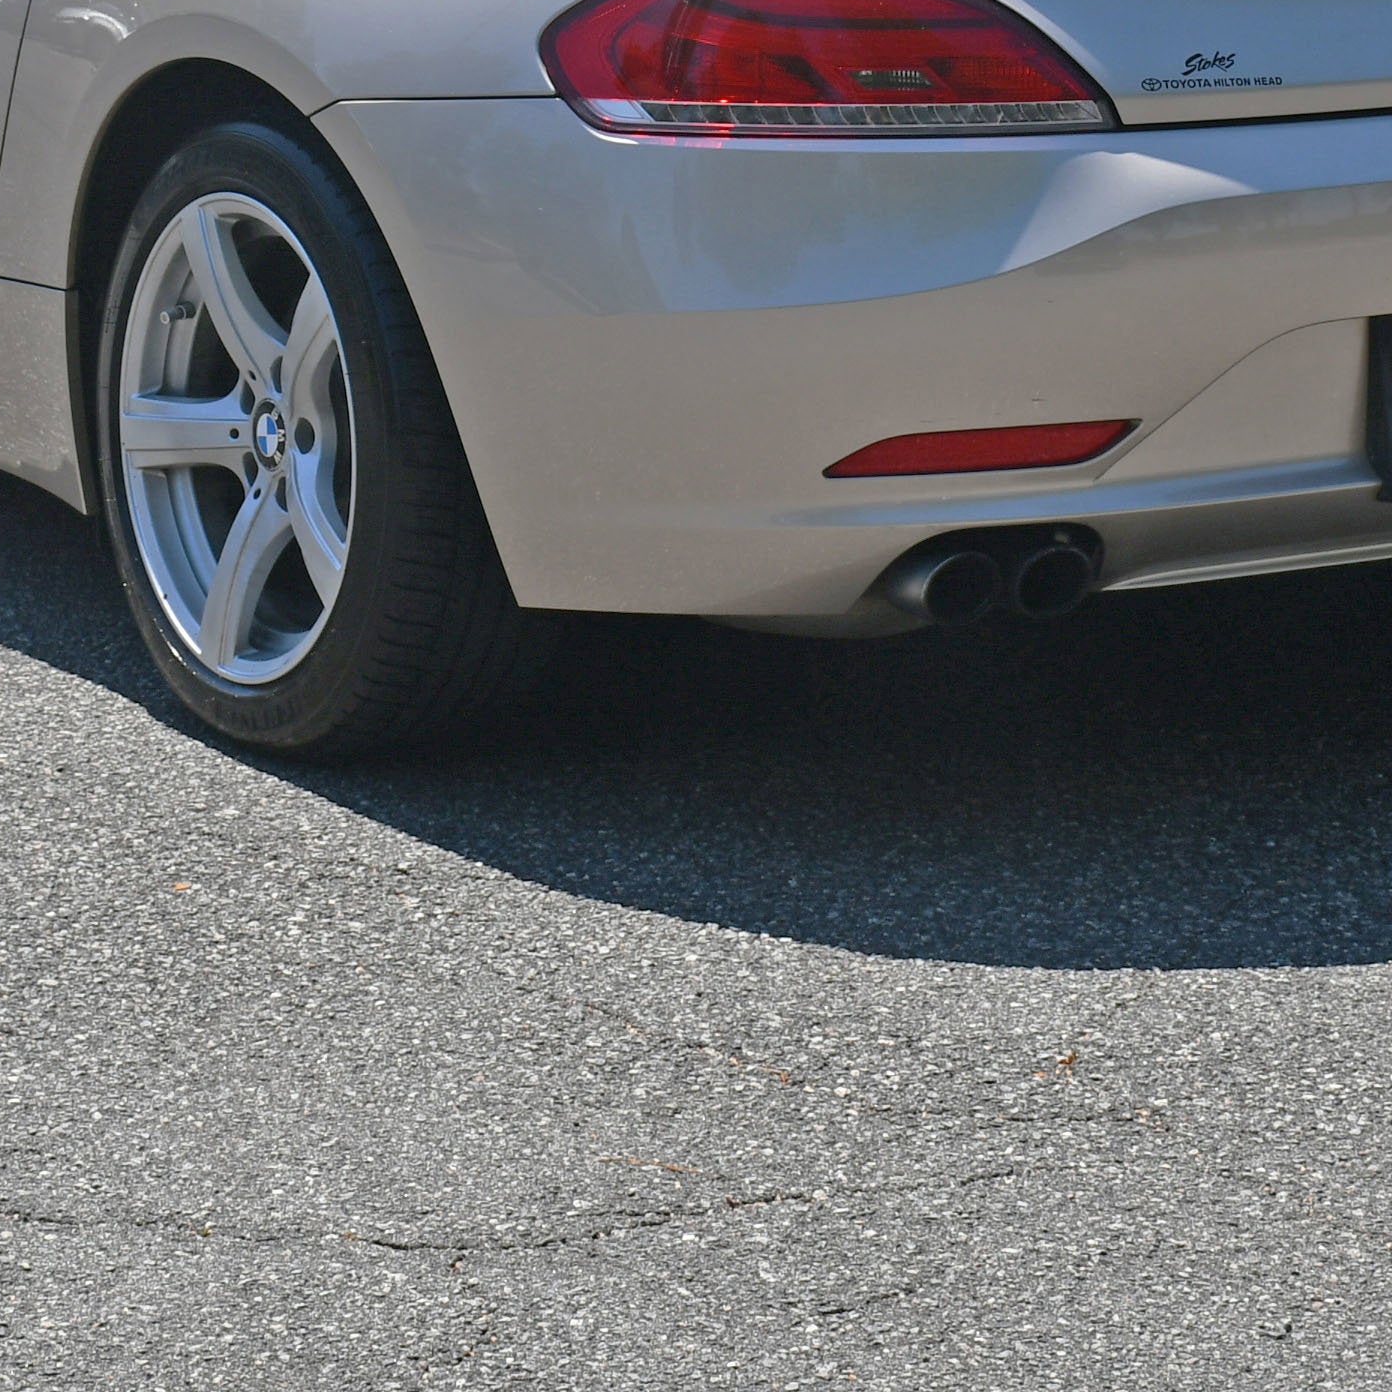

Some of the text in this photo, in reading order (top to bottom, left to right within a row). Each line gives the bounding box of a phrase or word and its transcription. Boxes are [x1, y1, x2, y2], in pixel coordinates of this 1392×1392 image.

[1181, 51, 1236, 75] Stokes
[1162, 76, 1282, 89] TOYOTA HILTON HEAD
